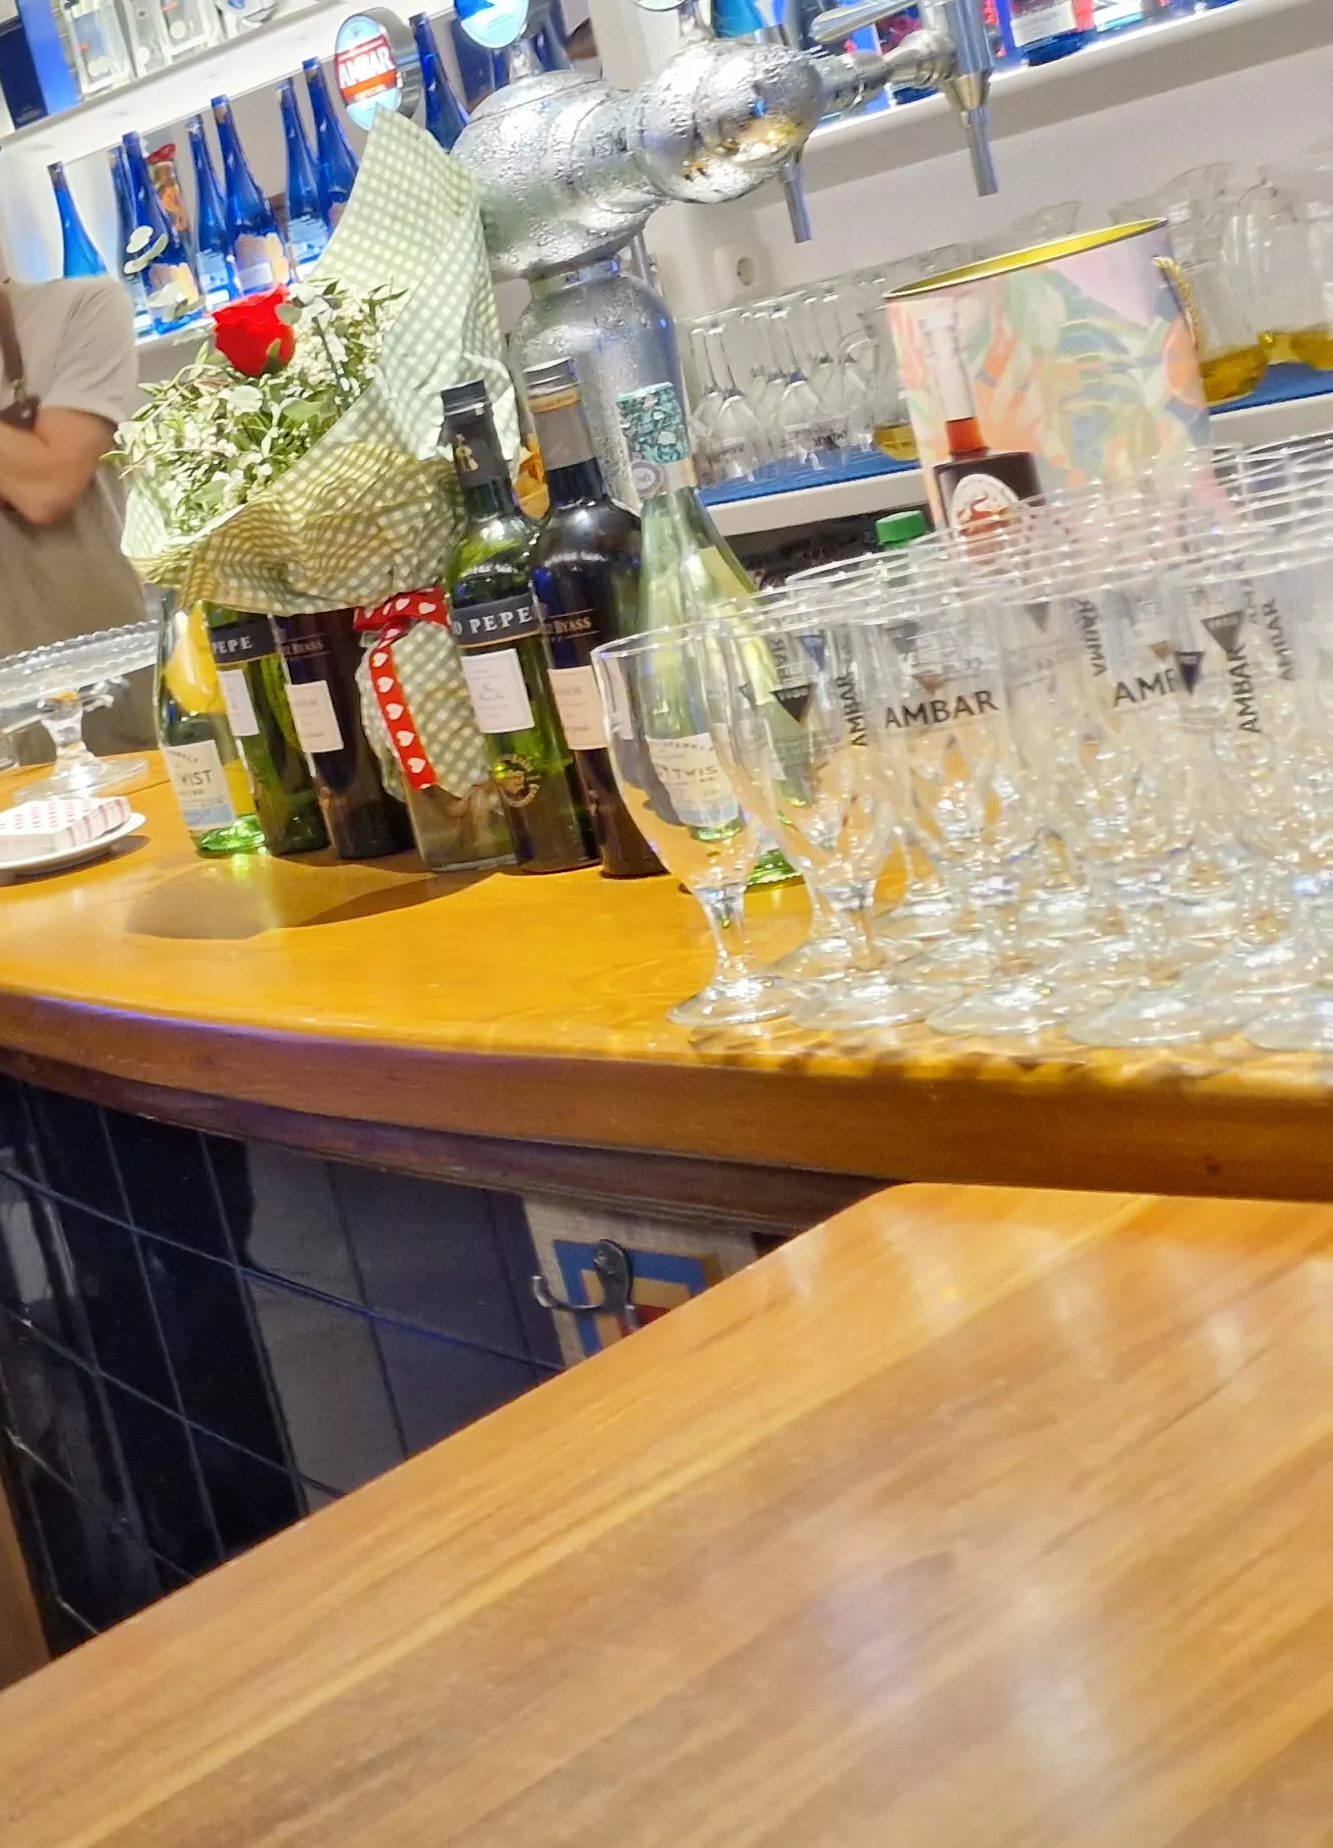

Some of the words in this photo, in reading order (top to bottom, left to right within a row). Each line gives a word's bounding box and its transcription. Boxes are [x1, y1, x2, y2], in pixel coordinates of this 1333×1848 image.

[338, 46, 396, 89] AMBAR
[469, 607, 532, 634] PEPE
[885, 690, 1000, 729] AMBAR
